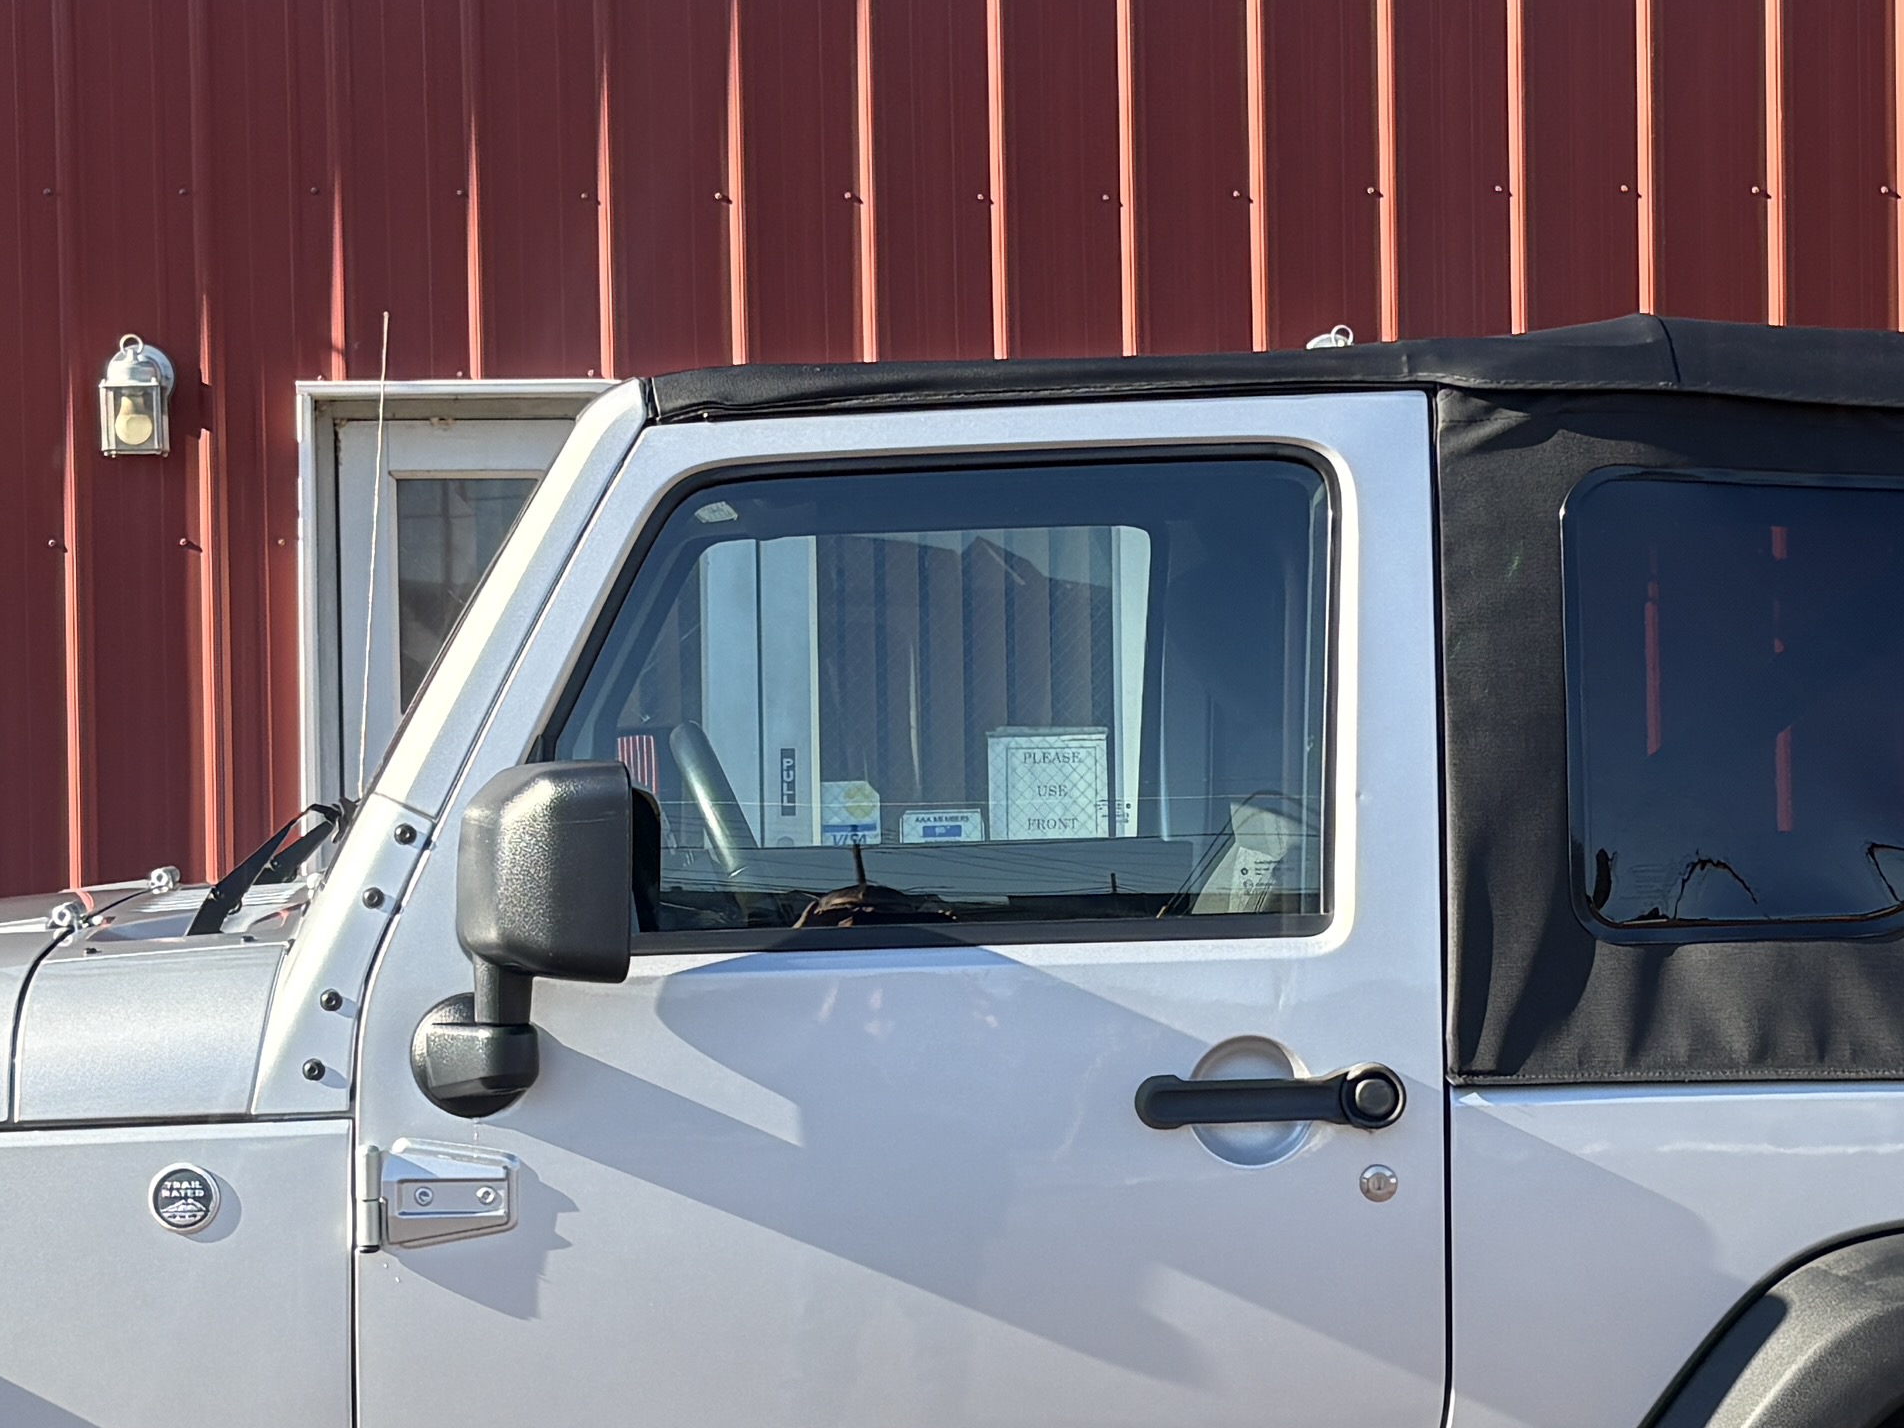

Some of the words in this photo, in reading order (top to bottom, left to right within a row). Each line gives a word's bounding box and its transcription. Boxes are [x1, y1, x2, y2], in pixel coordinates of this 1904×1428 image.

[1023, 751, 1083, 764] PLEASE
[783, 758, 794, 806] PULL
[1037, 785, 1068, 797] USE
[1027, 818, 1078, 830] FRONT
[832, 833, 867, 845] VISA
[163, 1180, 203, 1189] TRAIL
[161, 1188, 205, 1198] RATED
